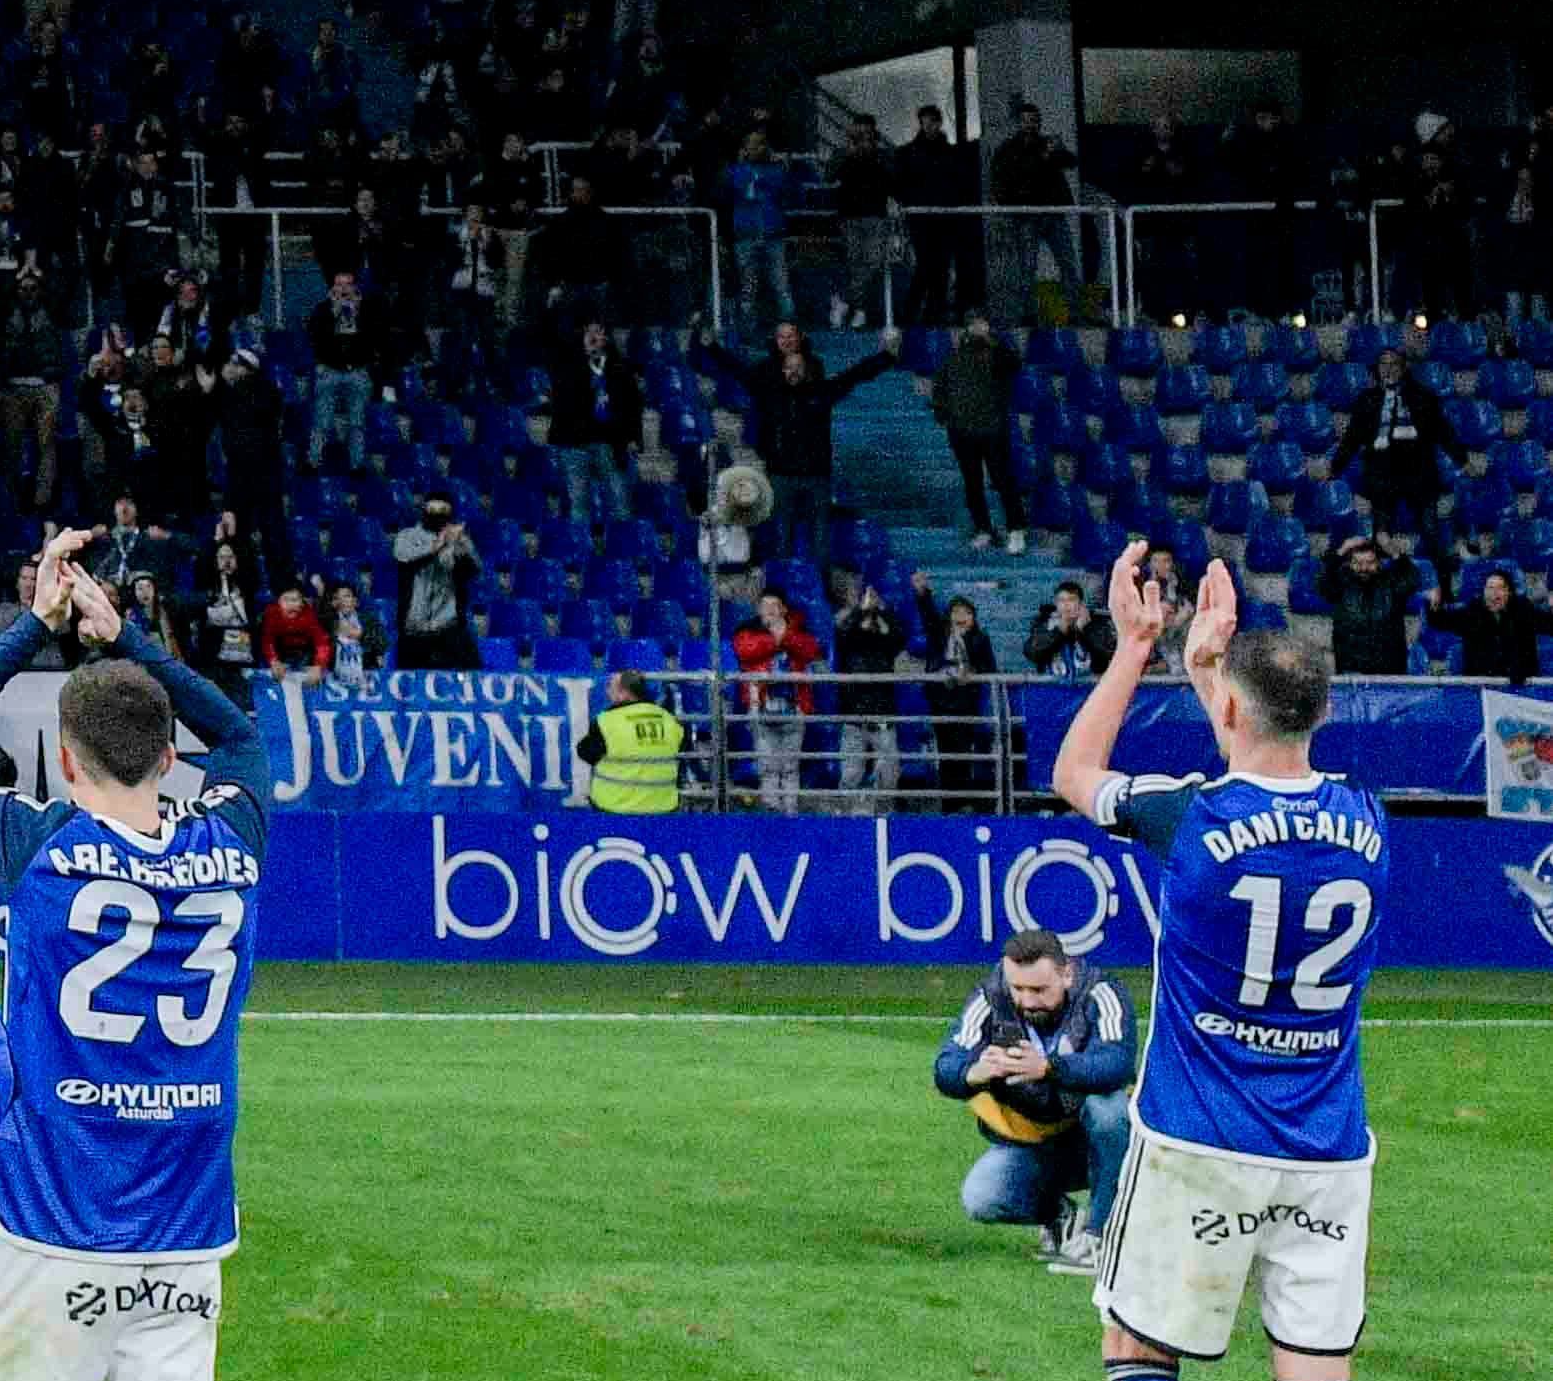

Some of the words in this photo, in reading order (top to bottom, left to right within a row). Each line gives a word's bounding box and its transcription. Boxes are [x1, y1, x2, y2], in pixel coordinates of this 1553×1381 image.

[1202, 810, 1290, 864] DANI
[1292, 810, 1382, 864] CALVO
[57, 880, 245, 1048] 23
[1228, 874, 1373, 1013] 12
[101, 1083, 222, 1108] HYUNDAI
